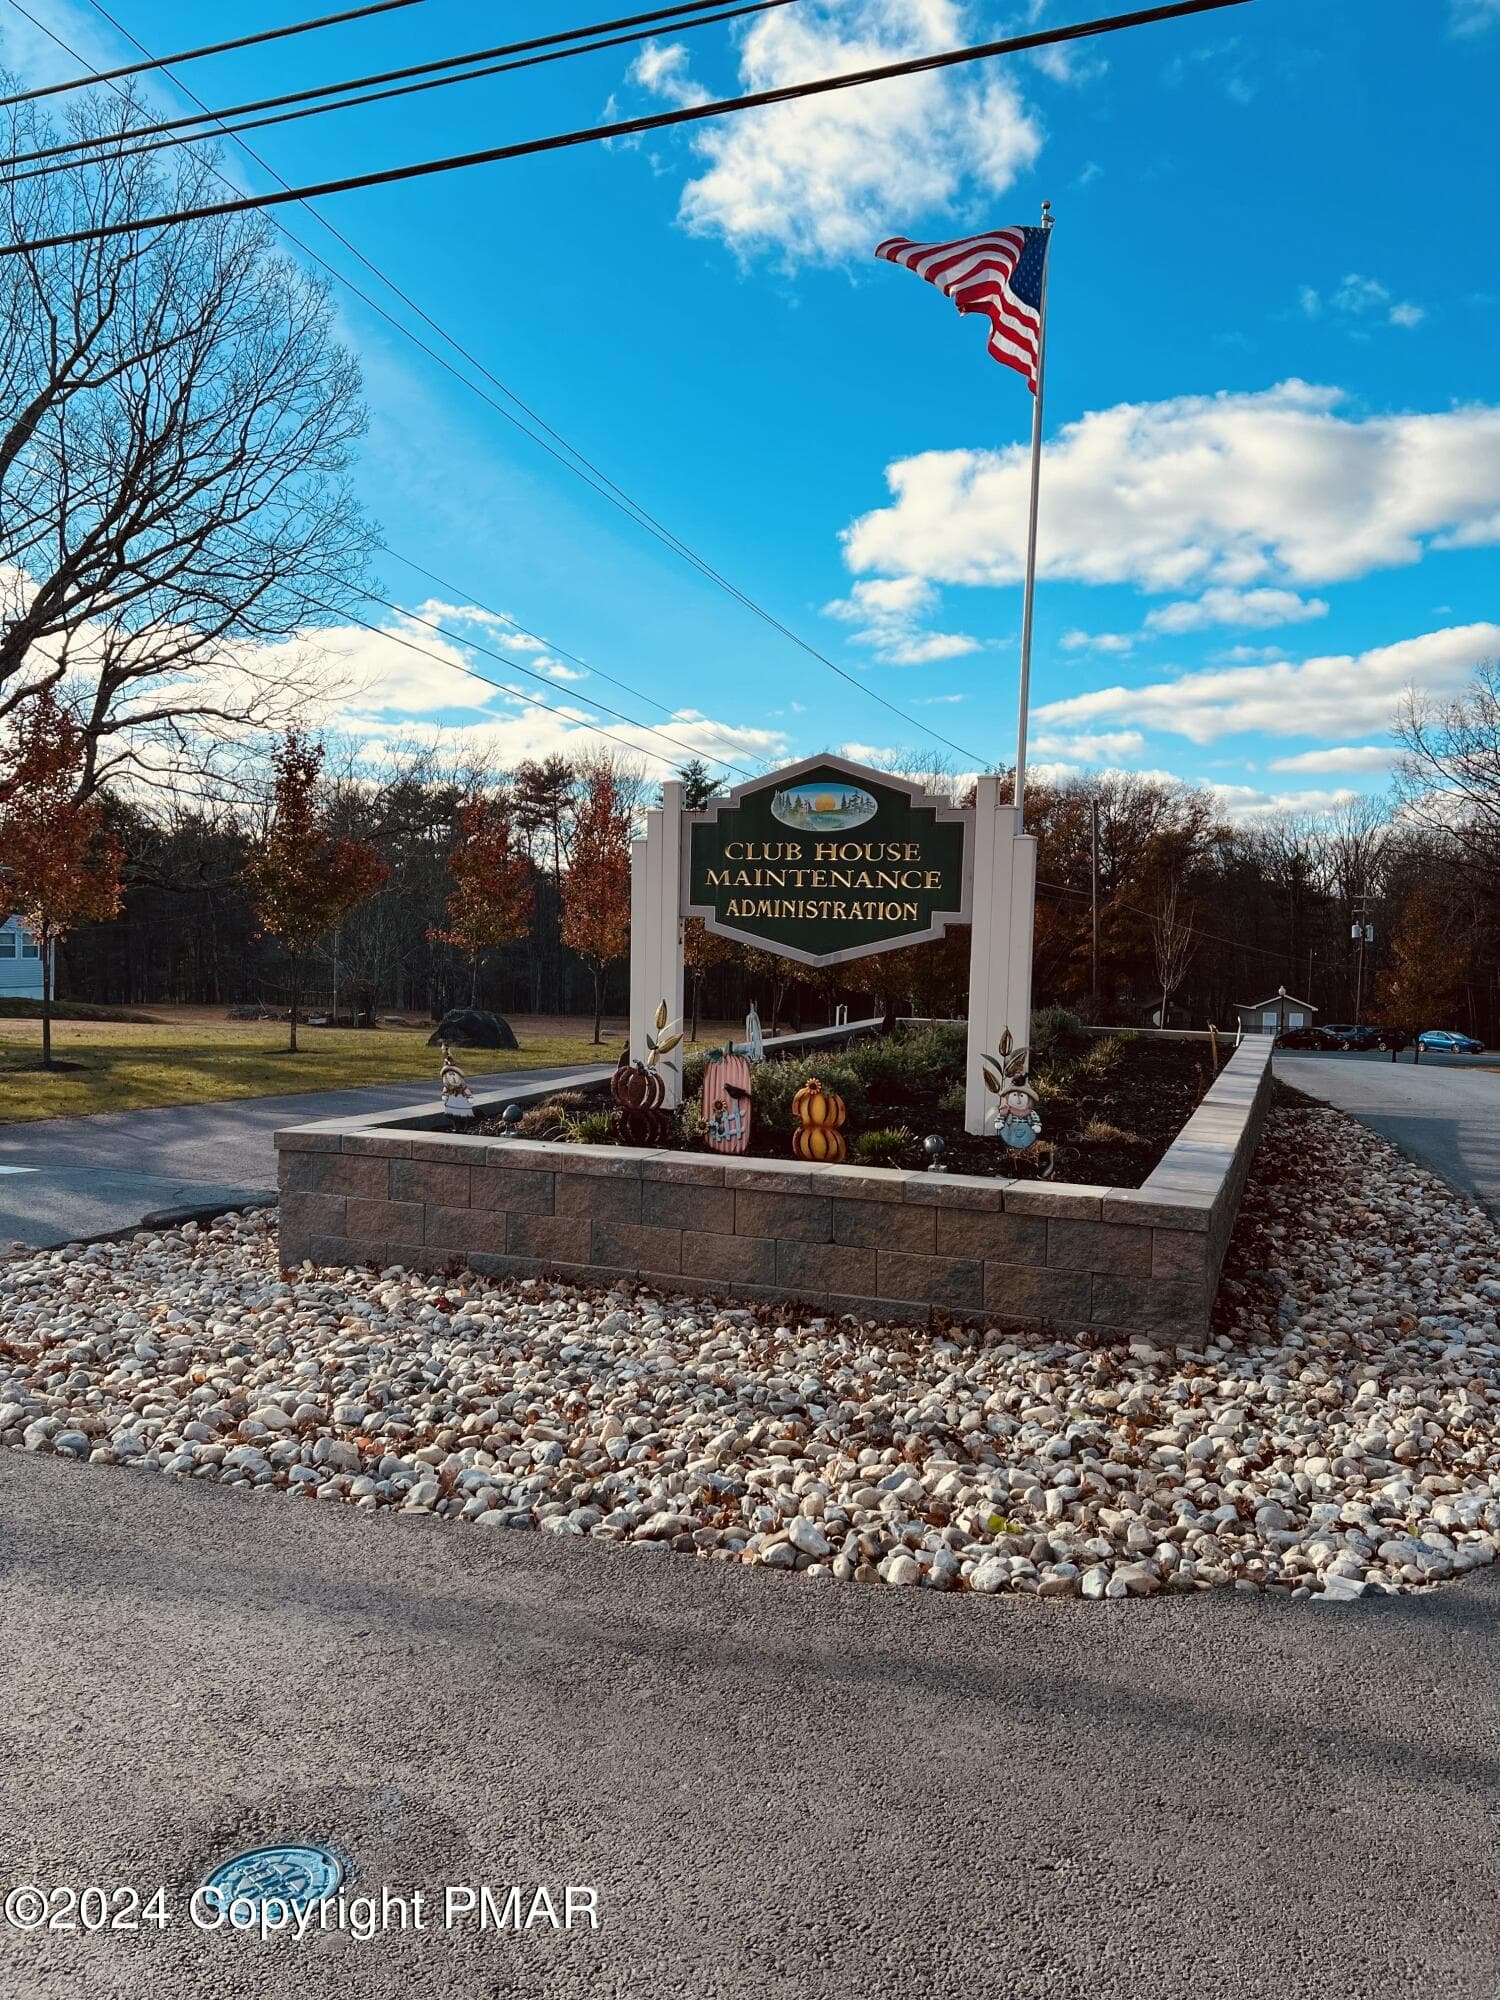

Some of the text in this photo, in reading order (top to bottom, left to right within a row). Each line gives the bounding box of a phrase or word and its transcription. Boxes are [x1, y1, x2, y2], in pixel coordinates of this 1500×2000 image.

[725, 842, 921, 862] CLUB HOUSE
[705, 868, 942, 889] MAINTENANCE
[725, 899, 918, 921] ADMINISTRATION
